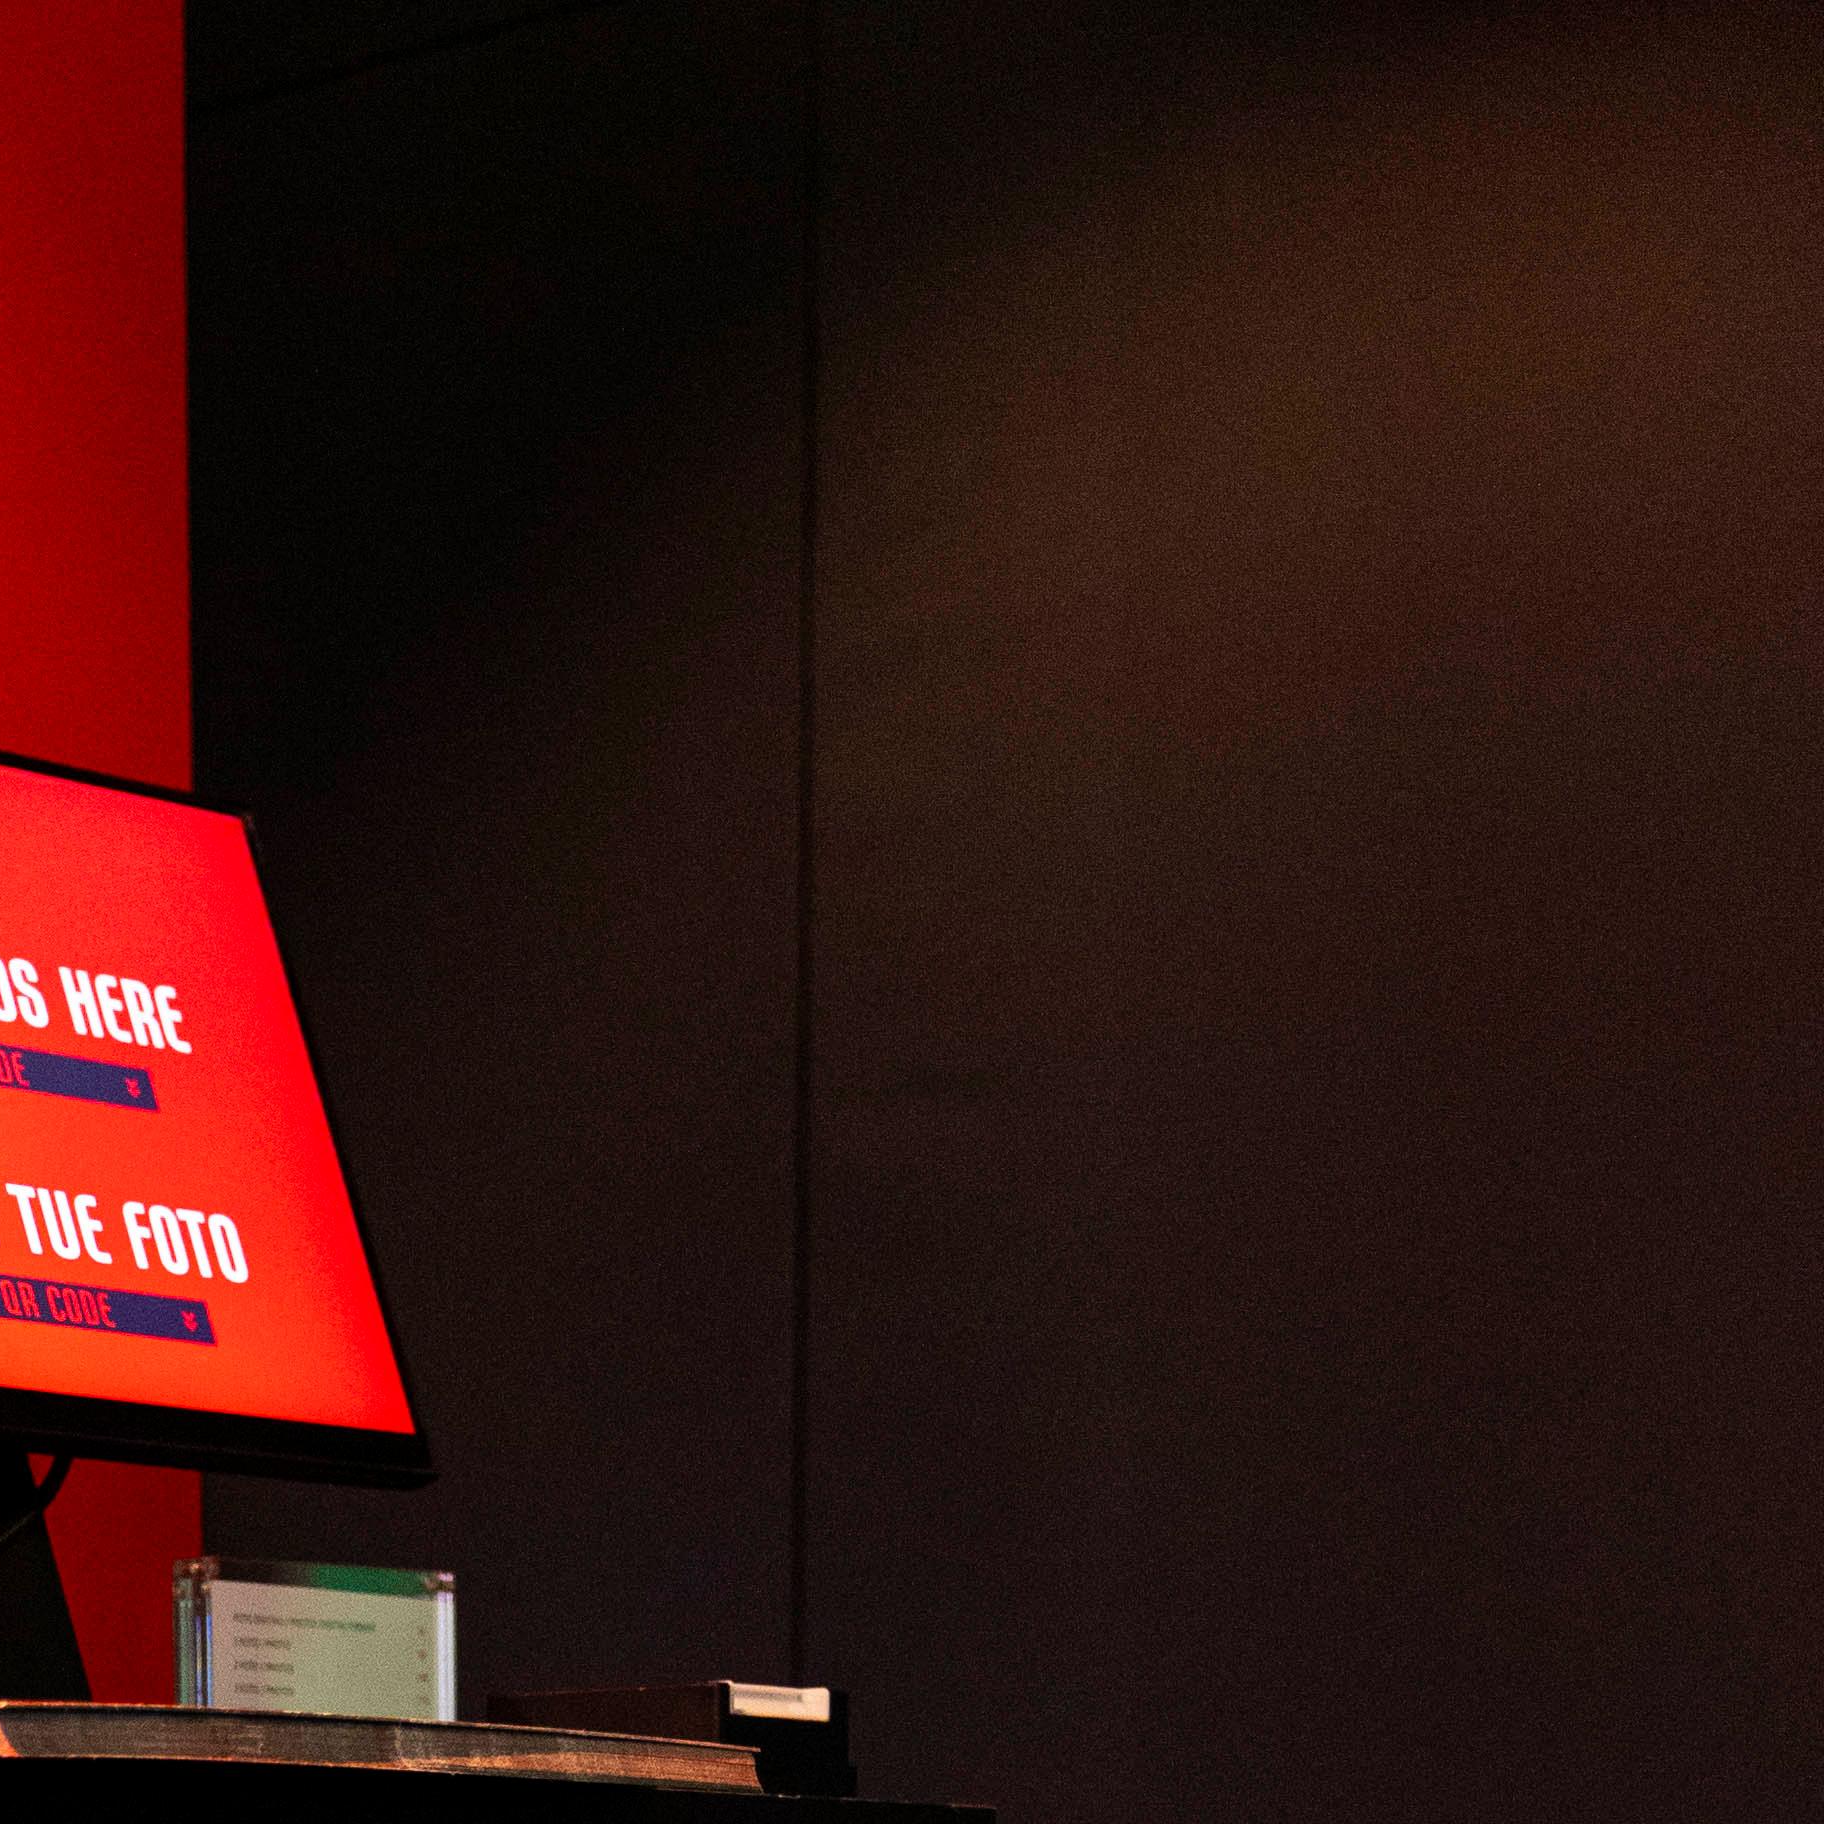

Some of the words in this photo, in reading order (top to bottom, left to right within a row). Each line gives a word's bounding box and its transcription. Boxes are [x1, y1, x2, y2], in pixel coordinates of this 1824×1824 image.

[58, 966, 192, 1054] HERE
[5, 1183, 113, 1264] TUE
[122, 1201, 249, 1283] FOTO
[0, 1279, 40, 1319] QR
[46, 1285, 116, 1328] CODE
